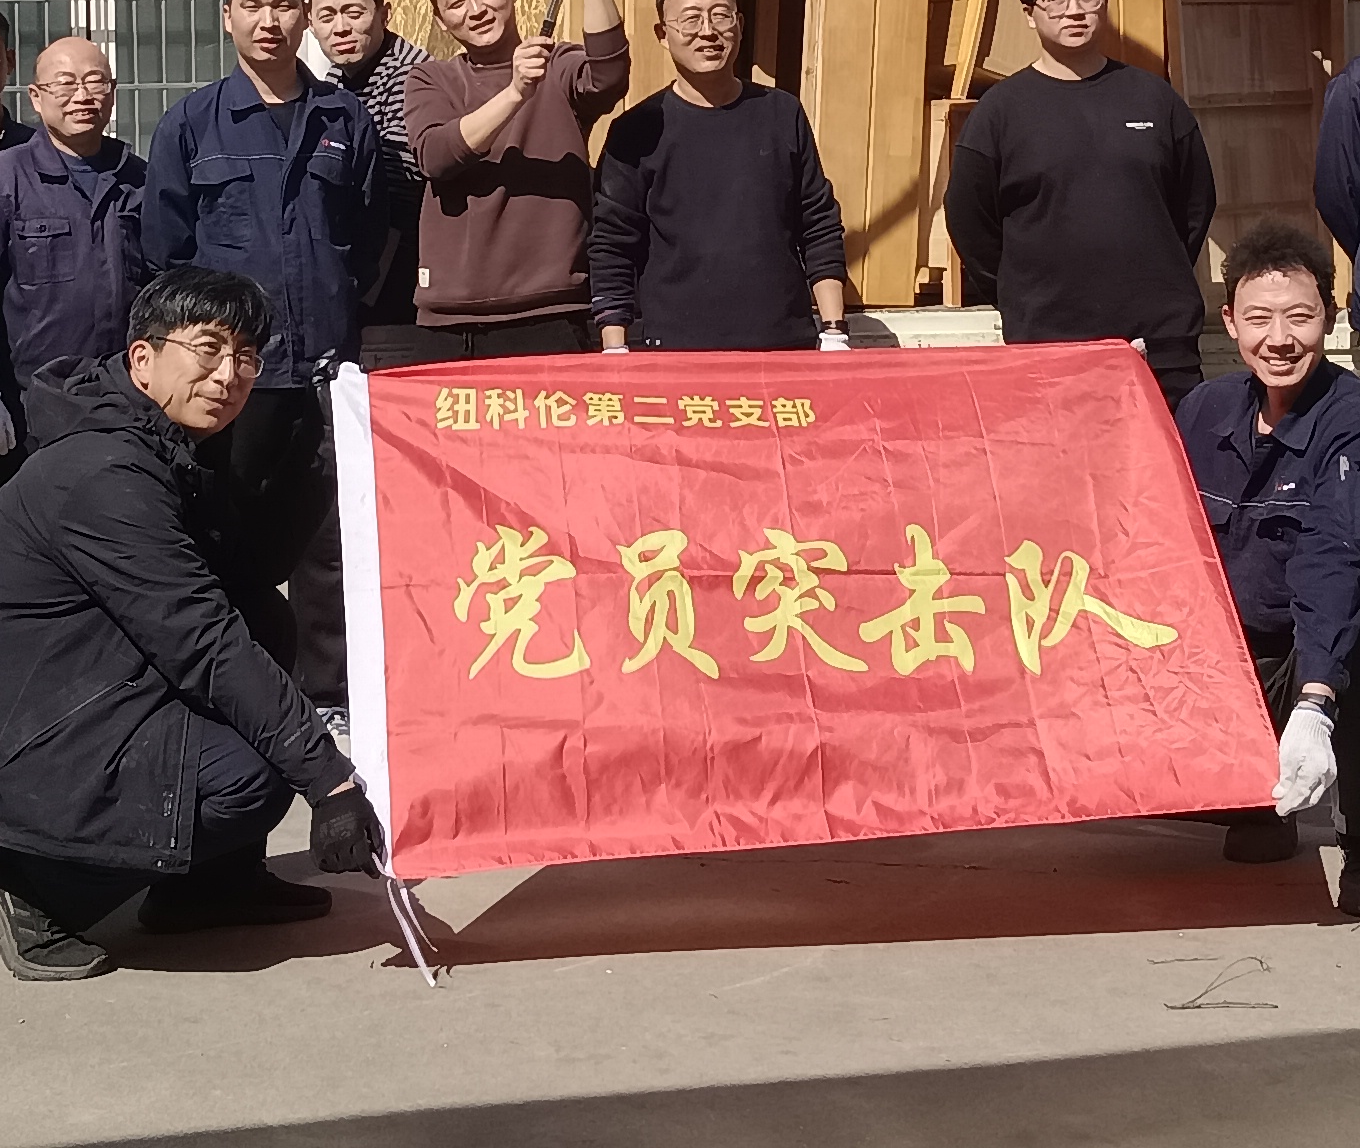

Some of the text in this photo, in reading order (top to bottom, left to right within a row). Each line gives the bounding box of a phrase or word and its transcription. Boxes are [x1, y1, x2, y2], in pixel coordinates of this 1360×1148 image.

[435, 387, 815, 431] 纽科伦第二党支部
[454, 524, 1179, 680] 党员突击队
